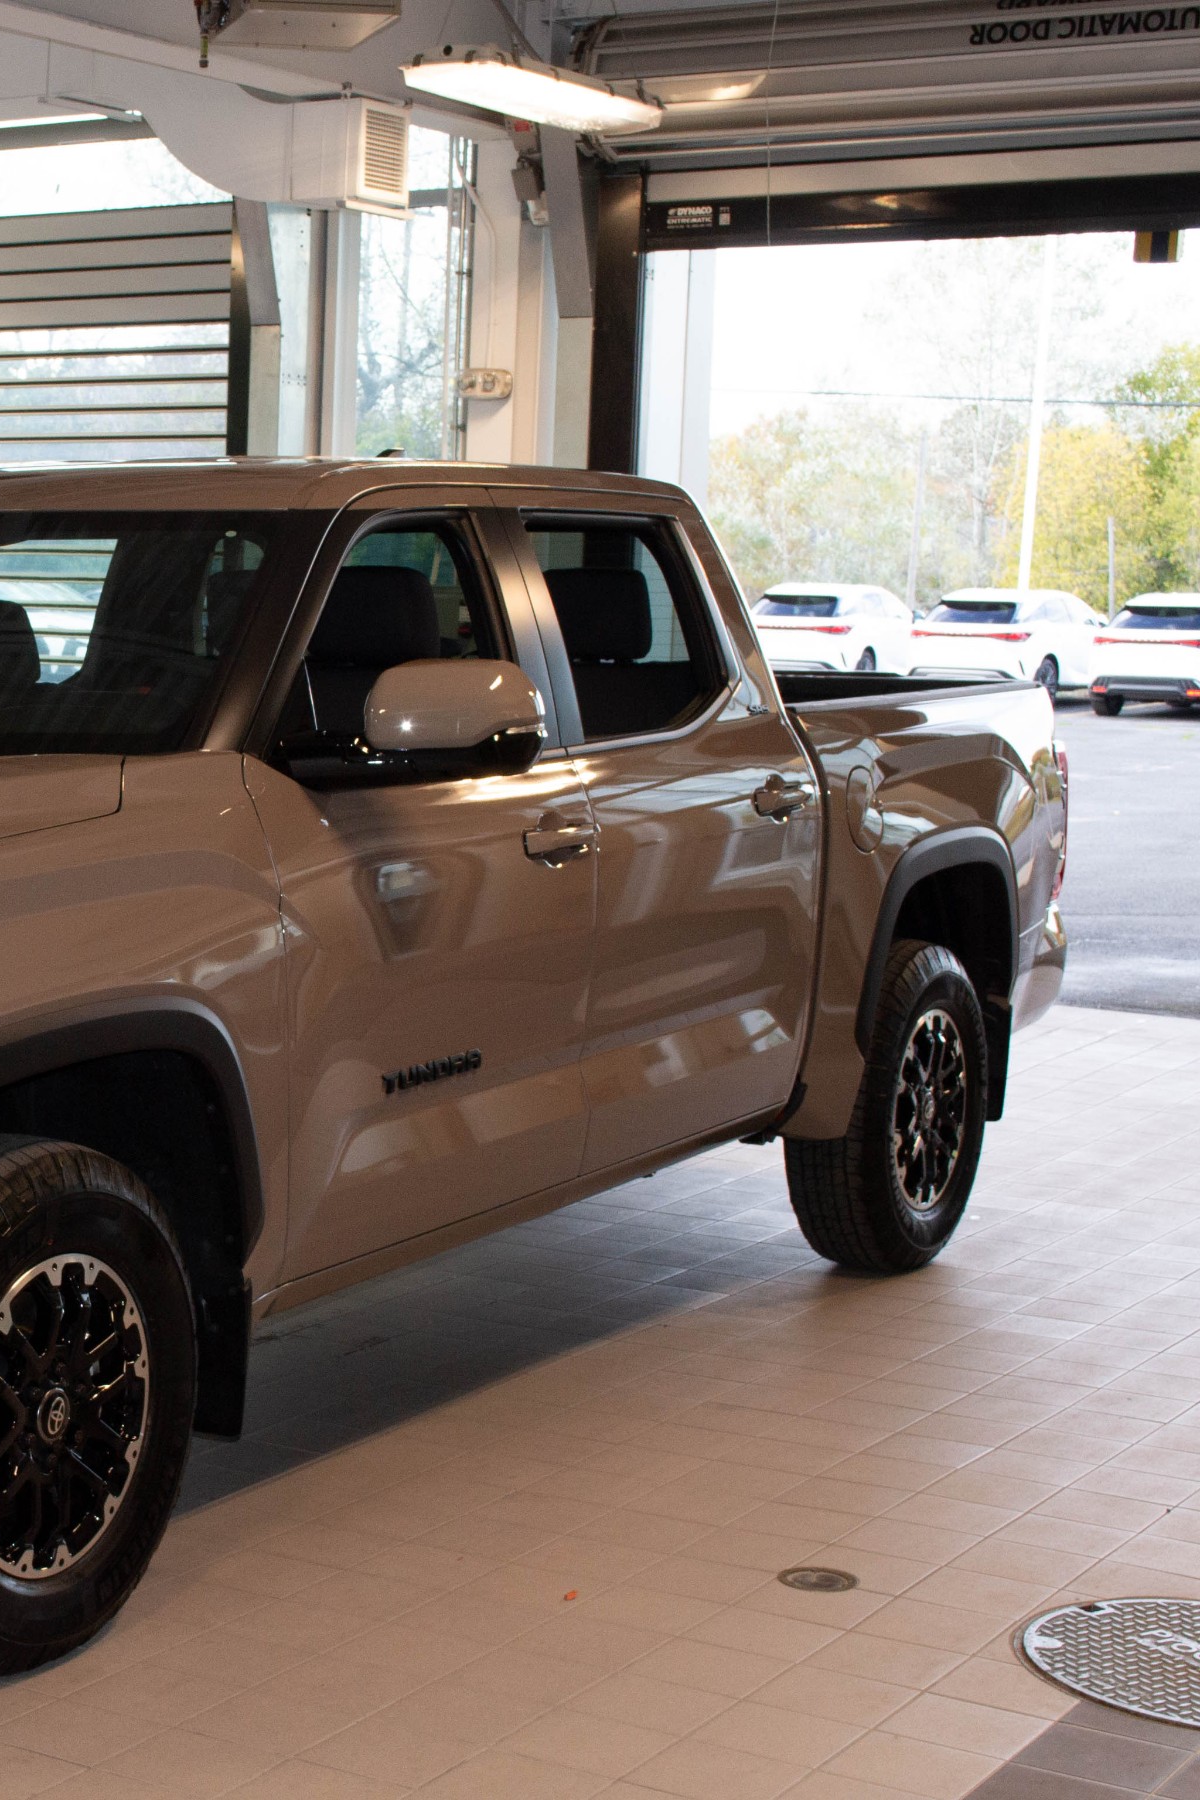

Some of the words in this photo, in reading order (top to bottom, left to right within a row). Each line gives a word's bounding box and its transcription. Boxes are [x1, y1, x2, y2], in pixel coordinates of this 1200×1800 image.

[969, 18, 1050, 46] DOOR
[1057, 6, 1200, 39] UTOMATIC
[676, 206, 713, 216] DYNACO
[382, 1048, 482, 1095] TUNDRA
